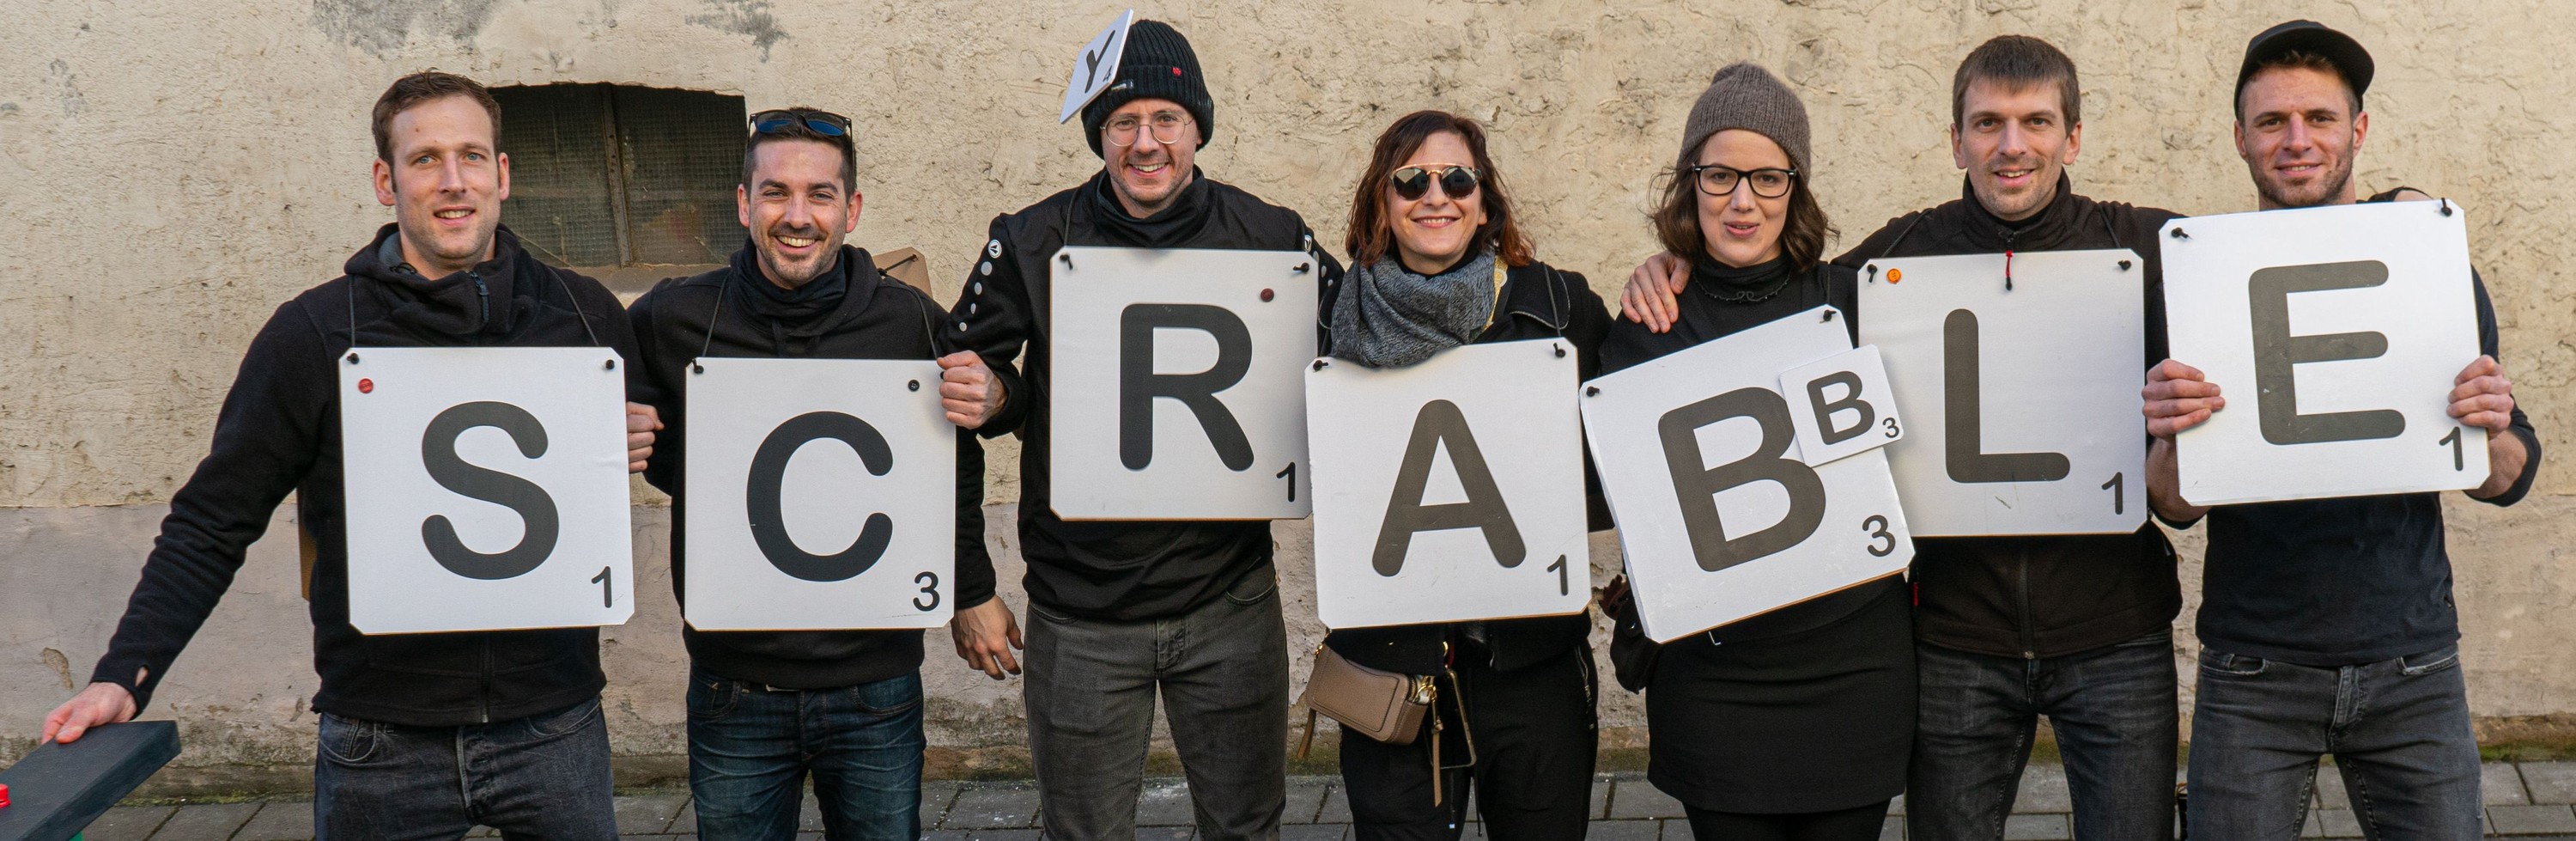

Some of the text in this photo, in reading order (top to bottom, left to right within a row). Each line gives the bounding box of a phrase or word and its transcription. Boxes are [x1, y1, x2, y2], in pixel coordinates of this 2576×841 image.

[1084, 29, 1115, 94] Y
[2248, 260, 2406, 446] E
[1119, 302, 1255, 472] R
[1806, 370, 1876, 446] B
[1943, 308, 2071, 484] L
[1882, 417, 1900, 440] 3
[2439, 426, 2464, 472] 1
[421, 400, 560, 581] S
[746, 411, 894, 582] C
[1276, 461, 1297, 503] 1
[1371, 399, 1527, 577] A
[1657, 386, 1827, 573] B
[2101, 471, 2123, 515] 1
[1862, 515, 1896, 558] 3
[591, 565, 612, 609] 1
[913, 570, 940, 612] 3
[1546, 554, 1569, 596] 1
